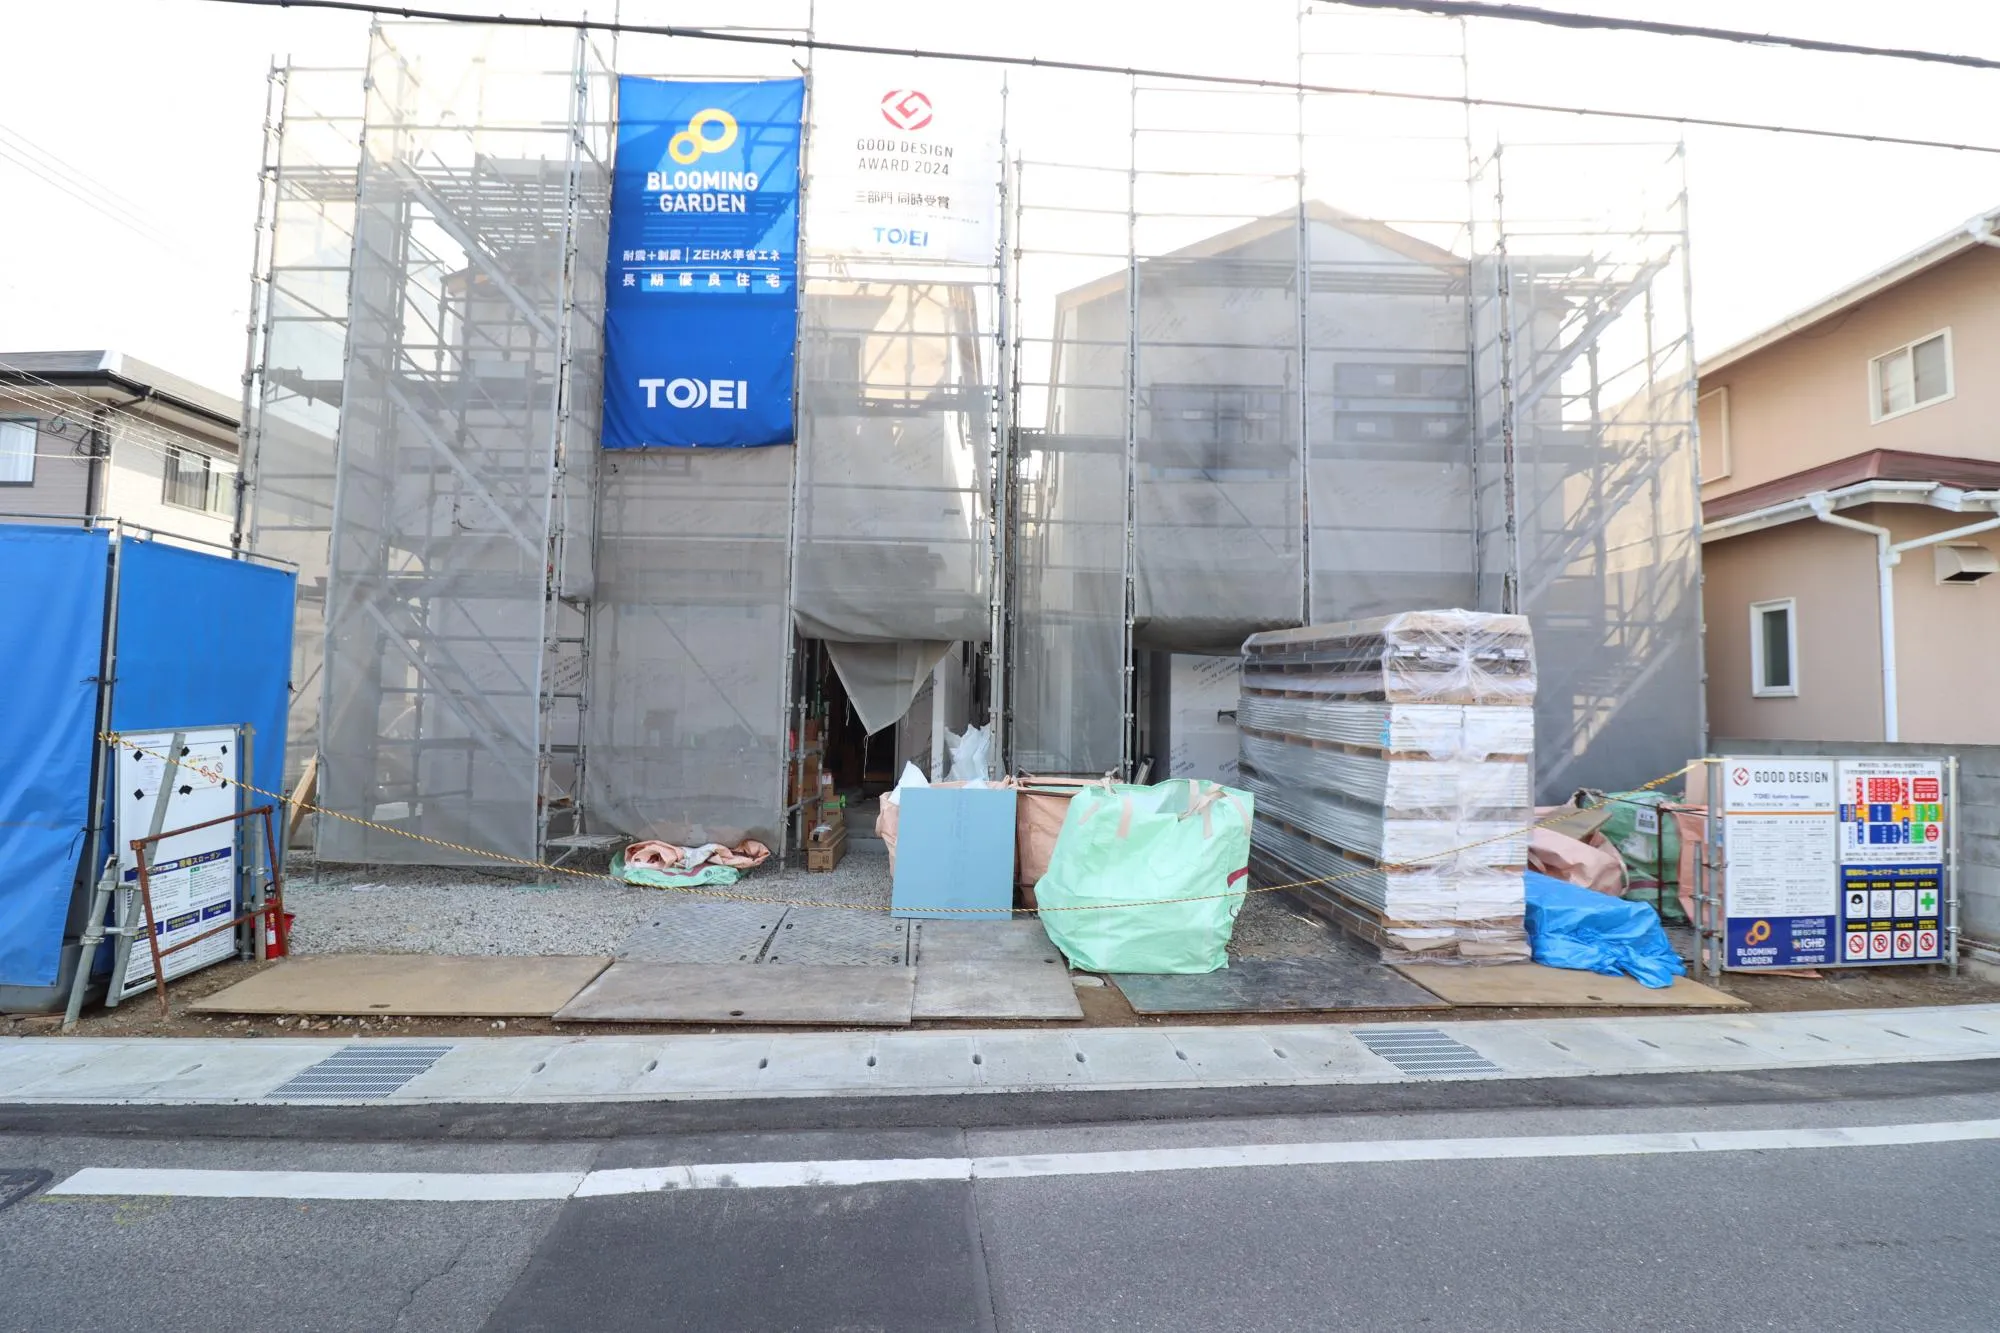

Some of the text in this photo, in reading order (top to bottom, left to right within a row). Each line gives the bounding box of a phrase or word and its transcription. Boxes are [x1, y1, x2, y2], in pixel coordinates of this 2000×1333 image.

[856, 138, 954, 158] GOOD DESIGN
[858, 157, 950, 176] AWARD 2024
[646, 171, 759, 191] BLOOMING
[659, 193, 746, 213] GARDEN
[692, 248, 780, 262] ZEH水準省エネ
[622, 271, 781, 289] 長期優良住宅
[639, 378, 748, 410] TOEI
[1754, 771, 1829, 783] GOOD DESIGN
[1736, 947, 1778, 957] BLOOMING
[1741, 956, 1774, 965] GARDEN
